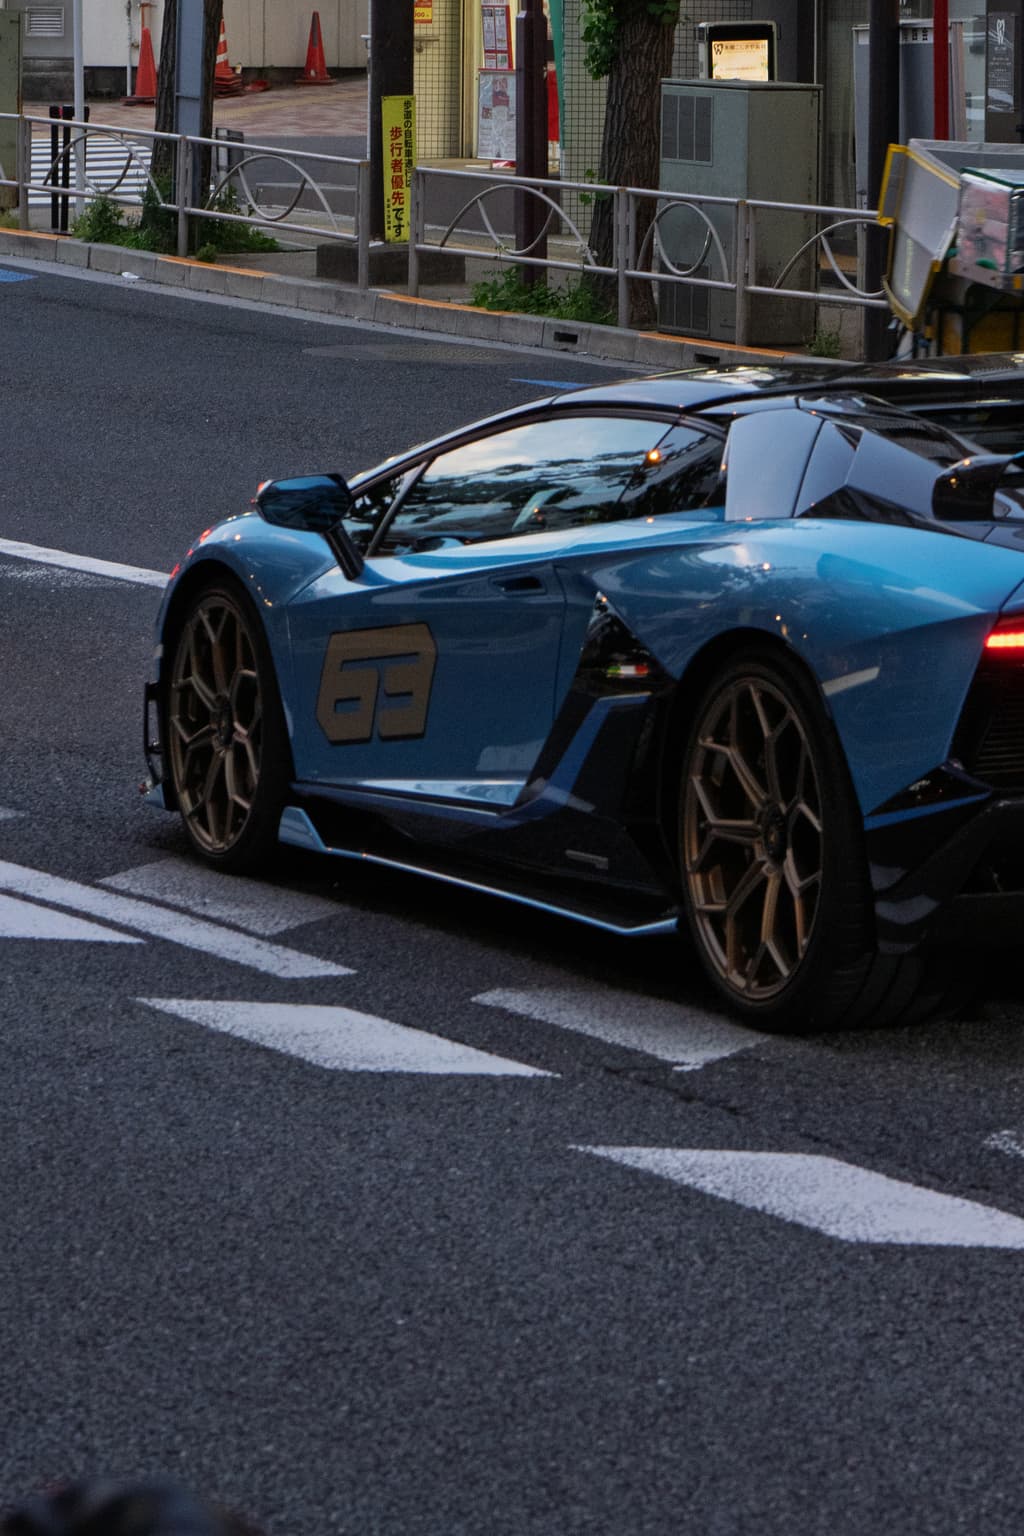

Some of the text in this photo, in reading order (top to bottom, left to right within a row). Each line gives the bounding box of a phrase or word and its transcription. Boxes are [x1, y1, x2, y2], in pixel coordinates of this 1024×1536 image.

[390, 126, 405, 237] 歩行者優先です
